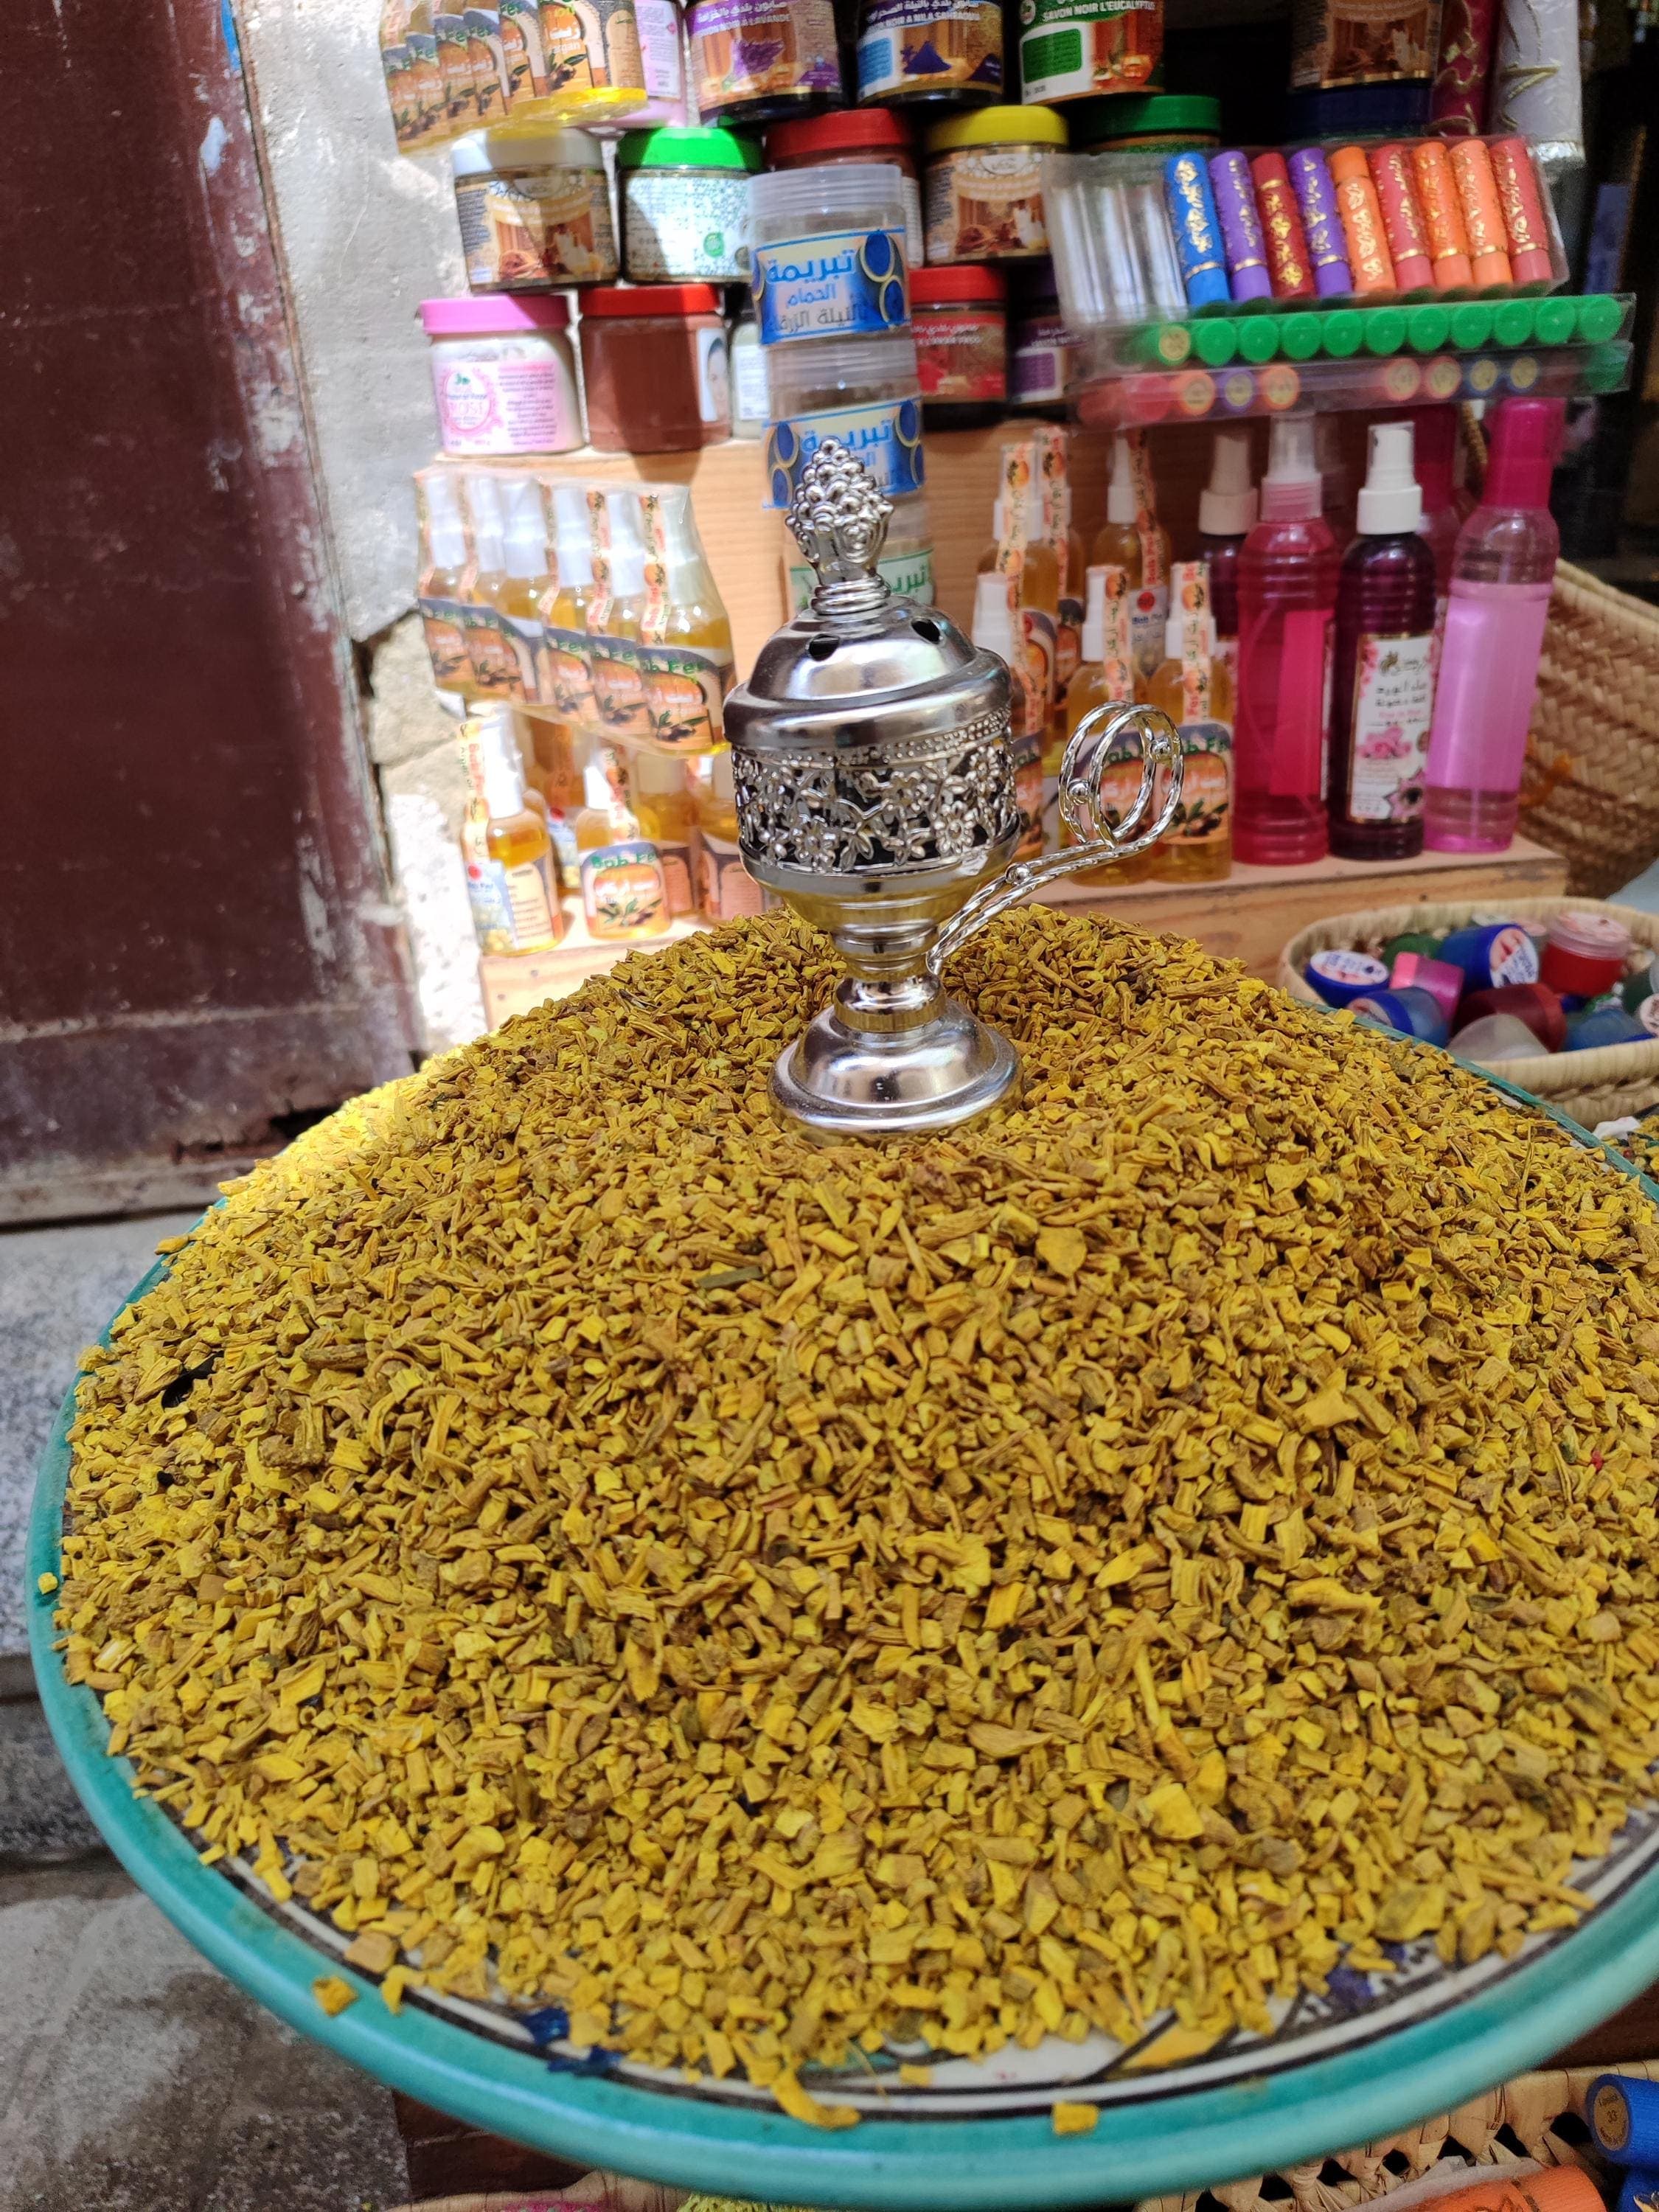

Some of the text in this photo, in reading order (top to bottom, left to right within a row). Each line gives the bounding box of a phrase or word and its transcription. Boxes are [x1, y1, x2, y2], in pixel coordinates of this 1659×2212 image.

[1042, 7, 1073, 21] SAVON
[1073, 3, 1098, 15] NOIR
[767, 248, 855, 283] تبريمة
[786, 283, 838, 310] الحمام
[801, 420, 894, 451] تبرية
